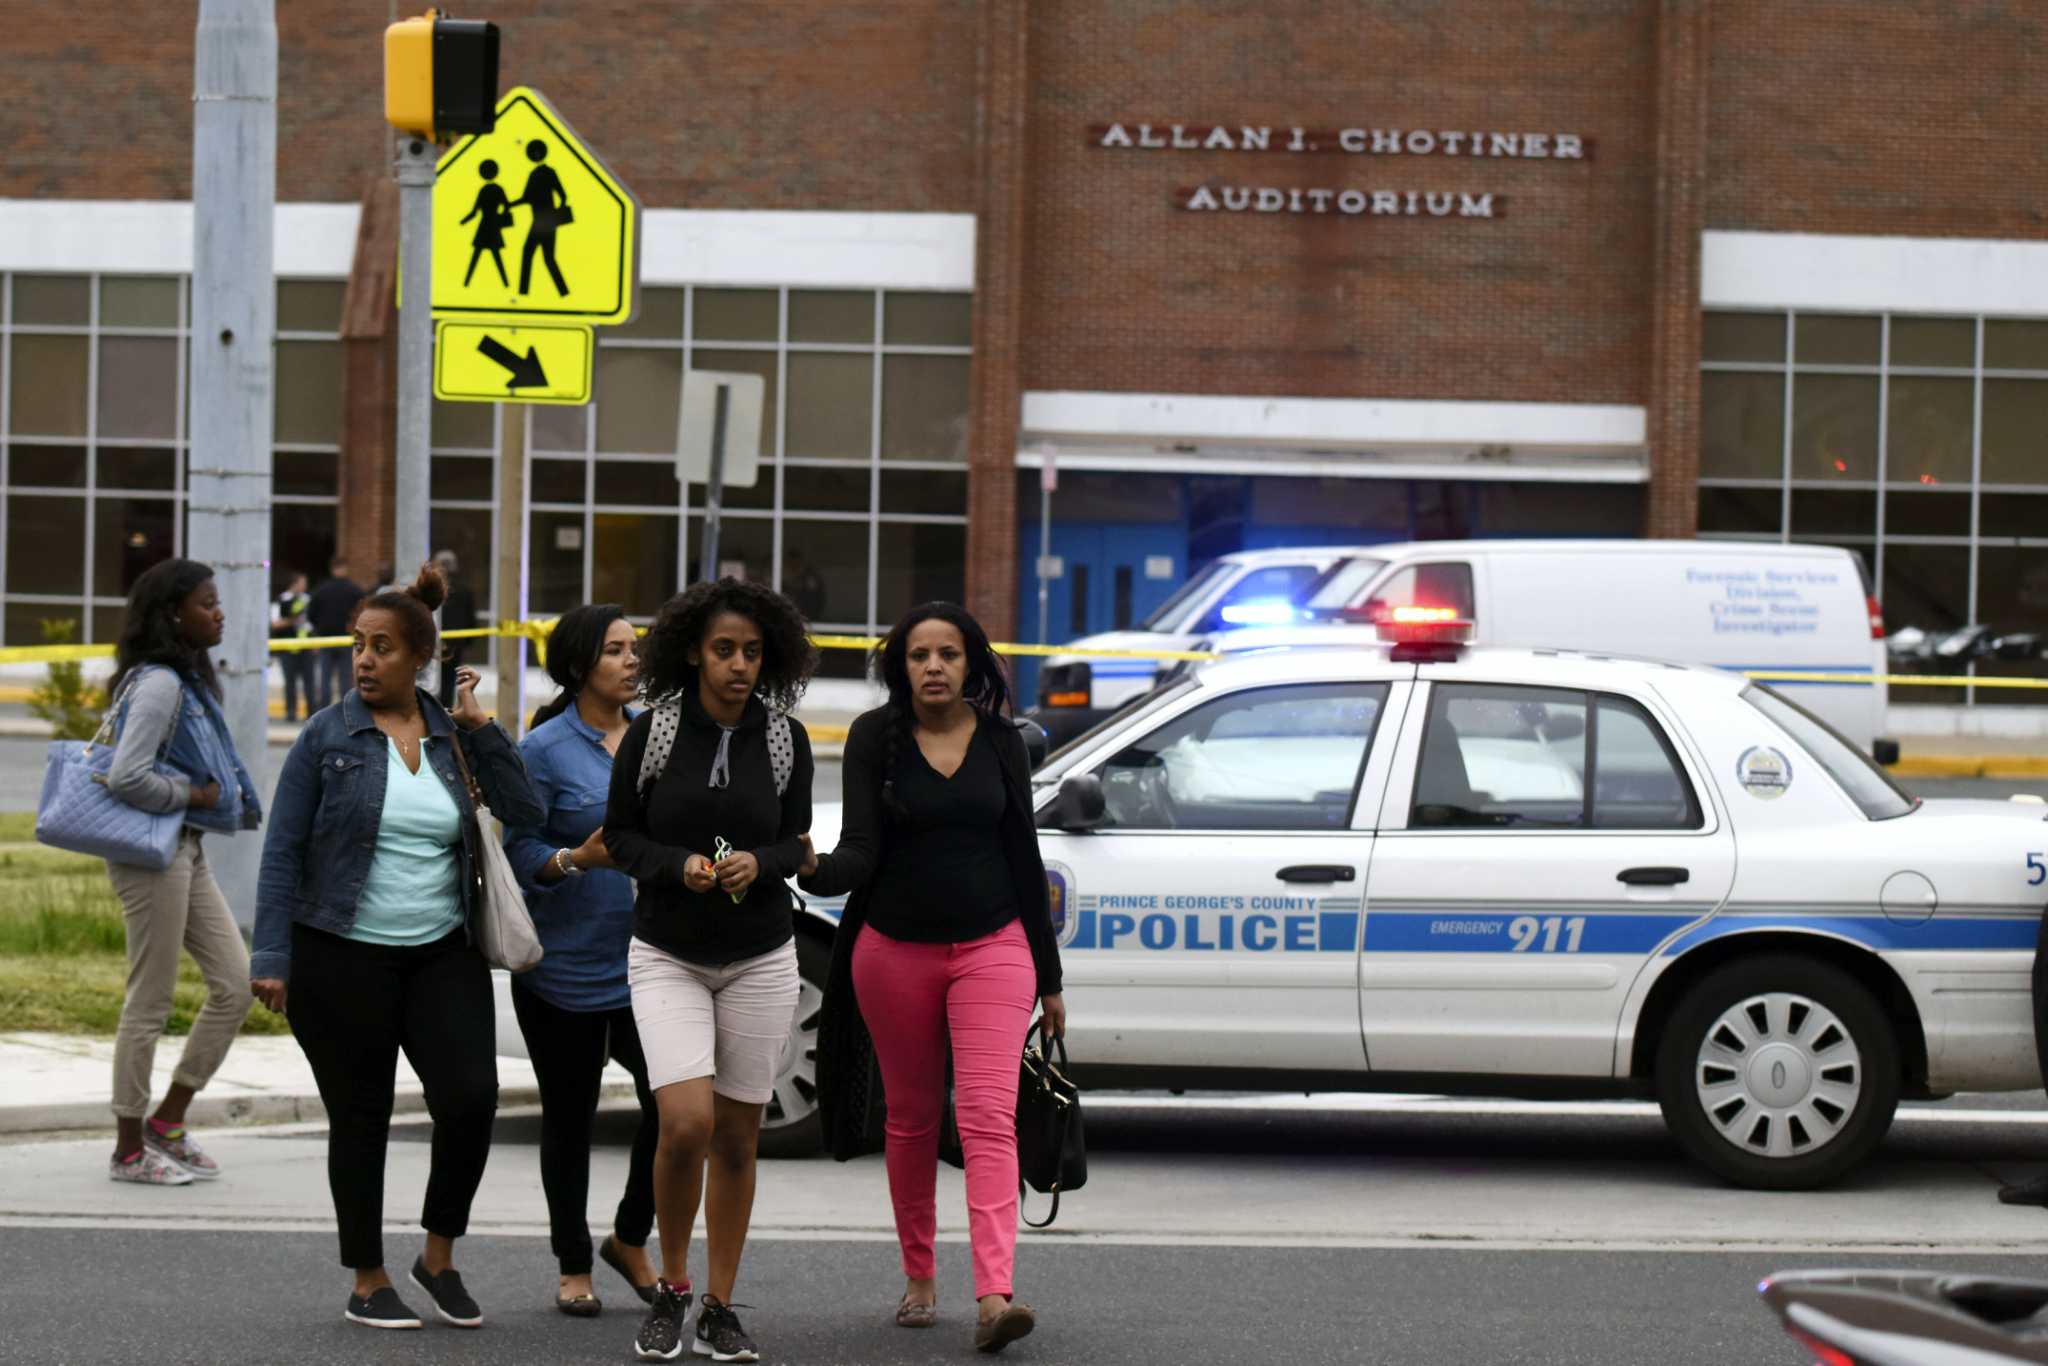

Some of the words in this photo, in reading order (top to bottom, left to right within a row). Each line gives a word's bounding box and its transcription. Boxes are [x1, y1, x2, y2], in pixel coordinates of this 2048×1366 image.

[1101, 123, 1271, 150] ALLAN
[1339, 128, 1584, 159] CHOTINER
[1187, 186, 1494, 218] AUDITORIUM
[1099, 895, 1159, 909] PRINCE
[1164, 896, 1244, 910] GEORGE'S
[1250, 896, 1316, 910] COUNTY
[1099, 914, 1317, 951] POLICE
[1430, 920, 1504, 935] EMERGENCY
[1508, 916, 1586, 953] 911
